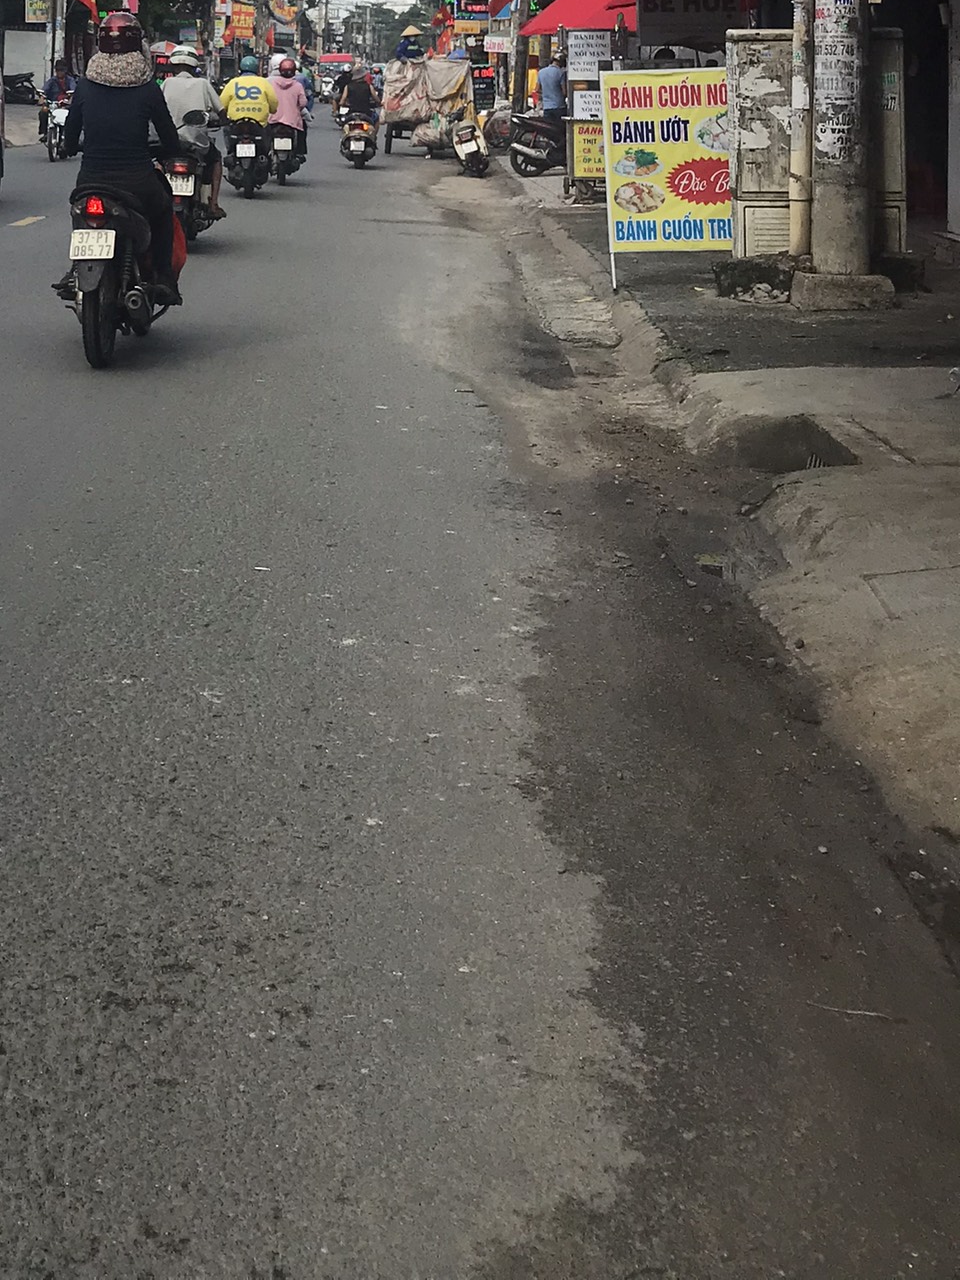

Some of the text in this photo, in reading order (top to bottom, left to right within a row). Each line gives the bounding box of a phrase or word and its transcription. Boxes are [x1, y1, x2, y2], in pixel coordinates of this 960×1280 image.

[235, 82, 262, 100] be
[609, 76, 728, 109] BÁNH CUỐN NÓ
[612, 115, 690, 143] BÁNH ƯỚT
[674, 169, 707, 195] Đặc
[78, 232, 109, 244] 37-P1
[615, 216, 657, 241] BÁNH
[662, 211, 704, 240] CUỐN
[73, 245, 112, 257] 085.77
